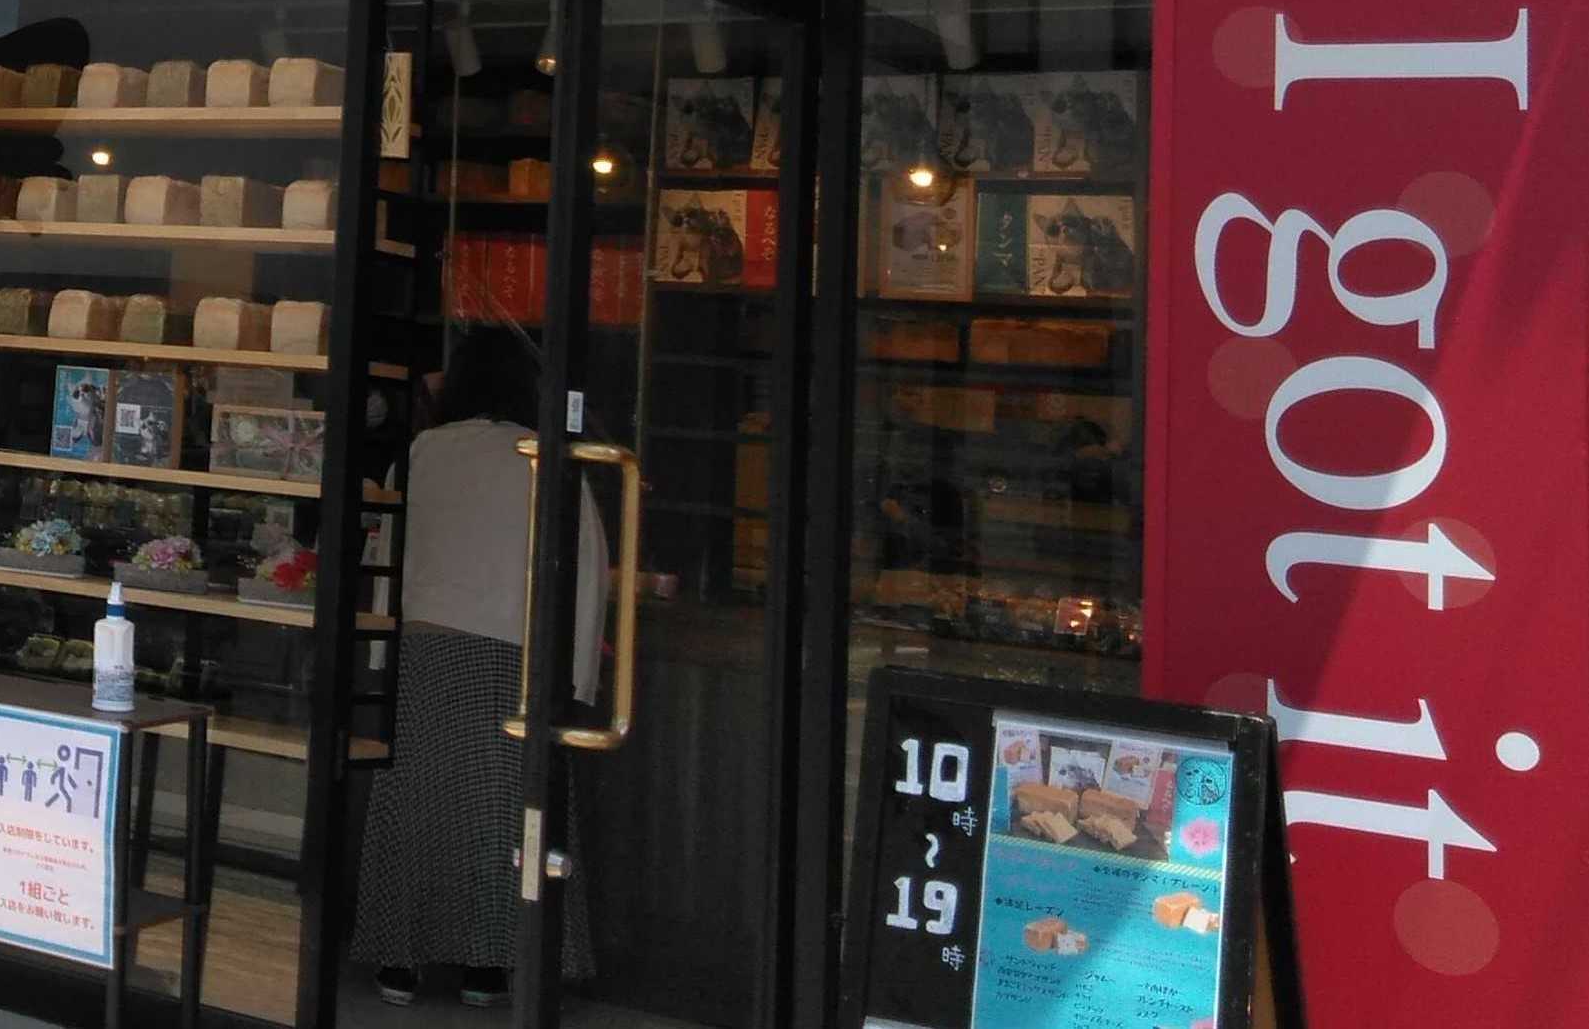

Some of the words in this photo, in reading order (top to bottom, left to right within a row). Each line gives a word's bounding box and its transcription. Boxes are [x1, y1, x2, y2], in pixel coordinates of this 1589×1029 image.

[1275, 8, 1528, 111] I
[1195, 193, 1496, 611] got
[1267, 677, 1540, 879] it
